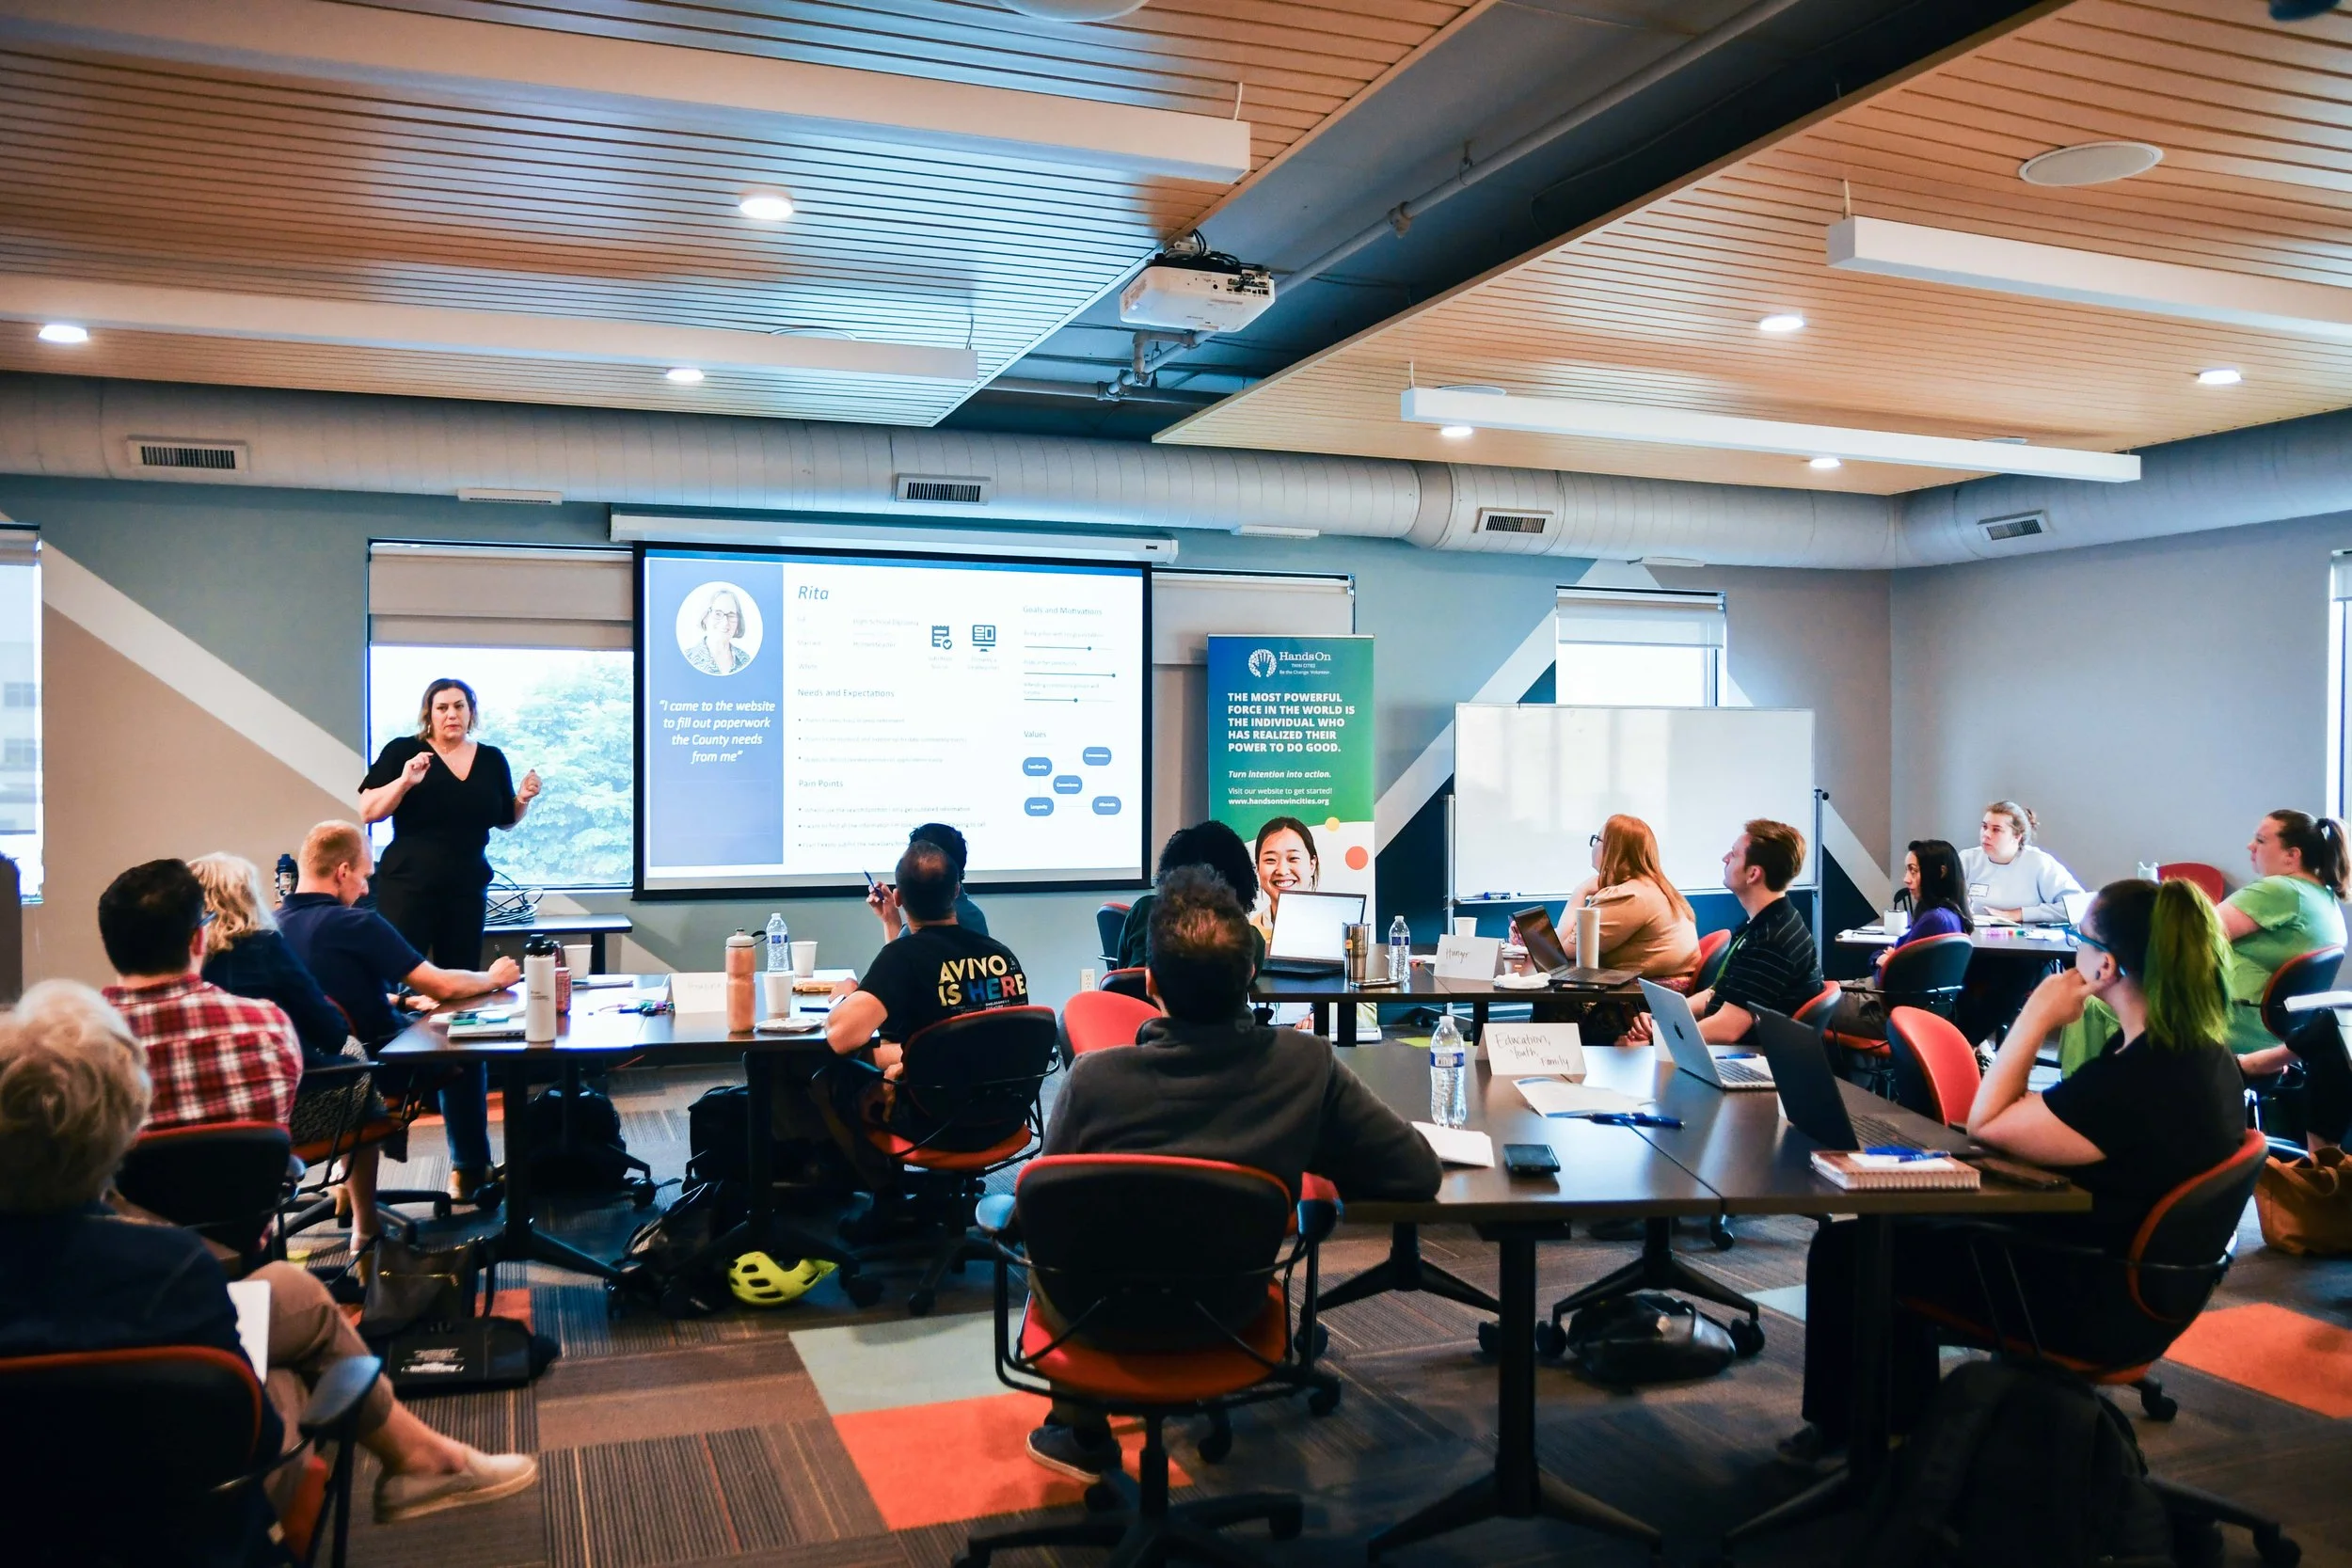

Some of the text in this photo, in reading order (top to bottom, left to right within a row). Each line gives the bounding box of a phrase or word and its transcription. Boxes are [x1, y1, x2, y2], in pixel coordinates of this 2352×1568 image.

[798, 585, 829, 601] Rita
[1023, 606, 1043, 614] Goals
[1059, 607, 1103, 616] Motivations
[1279, 651, 1332, 661] HandsOn
[797, 688, 896, 700] Needs and Expectations
[1227, 692, 1343, 703] THE MOST POWERFUL
[670, 702, 699, 712] came
[701, 701, 713, 712] to
[715, 700, 733, 712] the
[736, 700, 776, 712] website
[1228, 705, 1356, 715] FORCE IN THE WORLD IS
[663, 717, 771, 731] to fill out paperwork
[1227, 718, 1345, 727] THE INDIVIDUAL WHO
[1024, 730, 1047, 738] Values
[1228, 730, 1337, 740] HAS REALIZED THEIR
[671, 733, 763, 748] the County needs
[1228, 742, 1342, 752] POWER TO DO GOOD.
[691, 751, 717, 765] from
[1228, 769, 1332, 779] Turn intention into action.
[798, 779, 844, 788] Pain Points
[1294, 788, 1305, 797] get
[1228, 797, 1330, 806] www.handsontwincities.org
[938, 955, 1008, 984] AVIVO
[938, 973, 1026, 1006] IS HERE
[1495, 1032, 1551, 1049] Education,
[1540, 1054, 1570, 1070] Family
